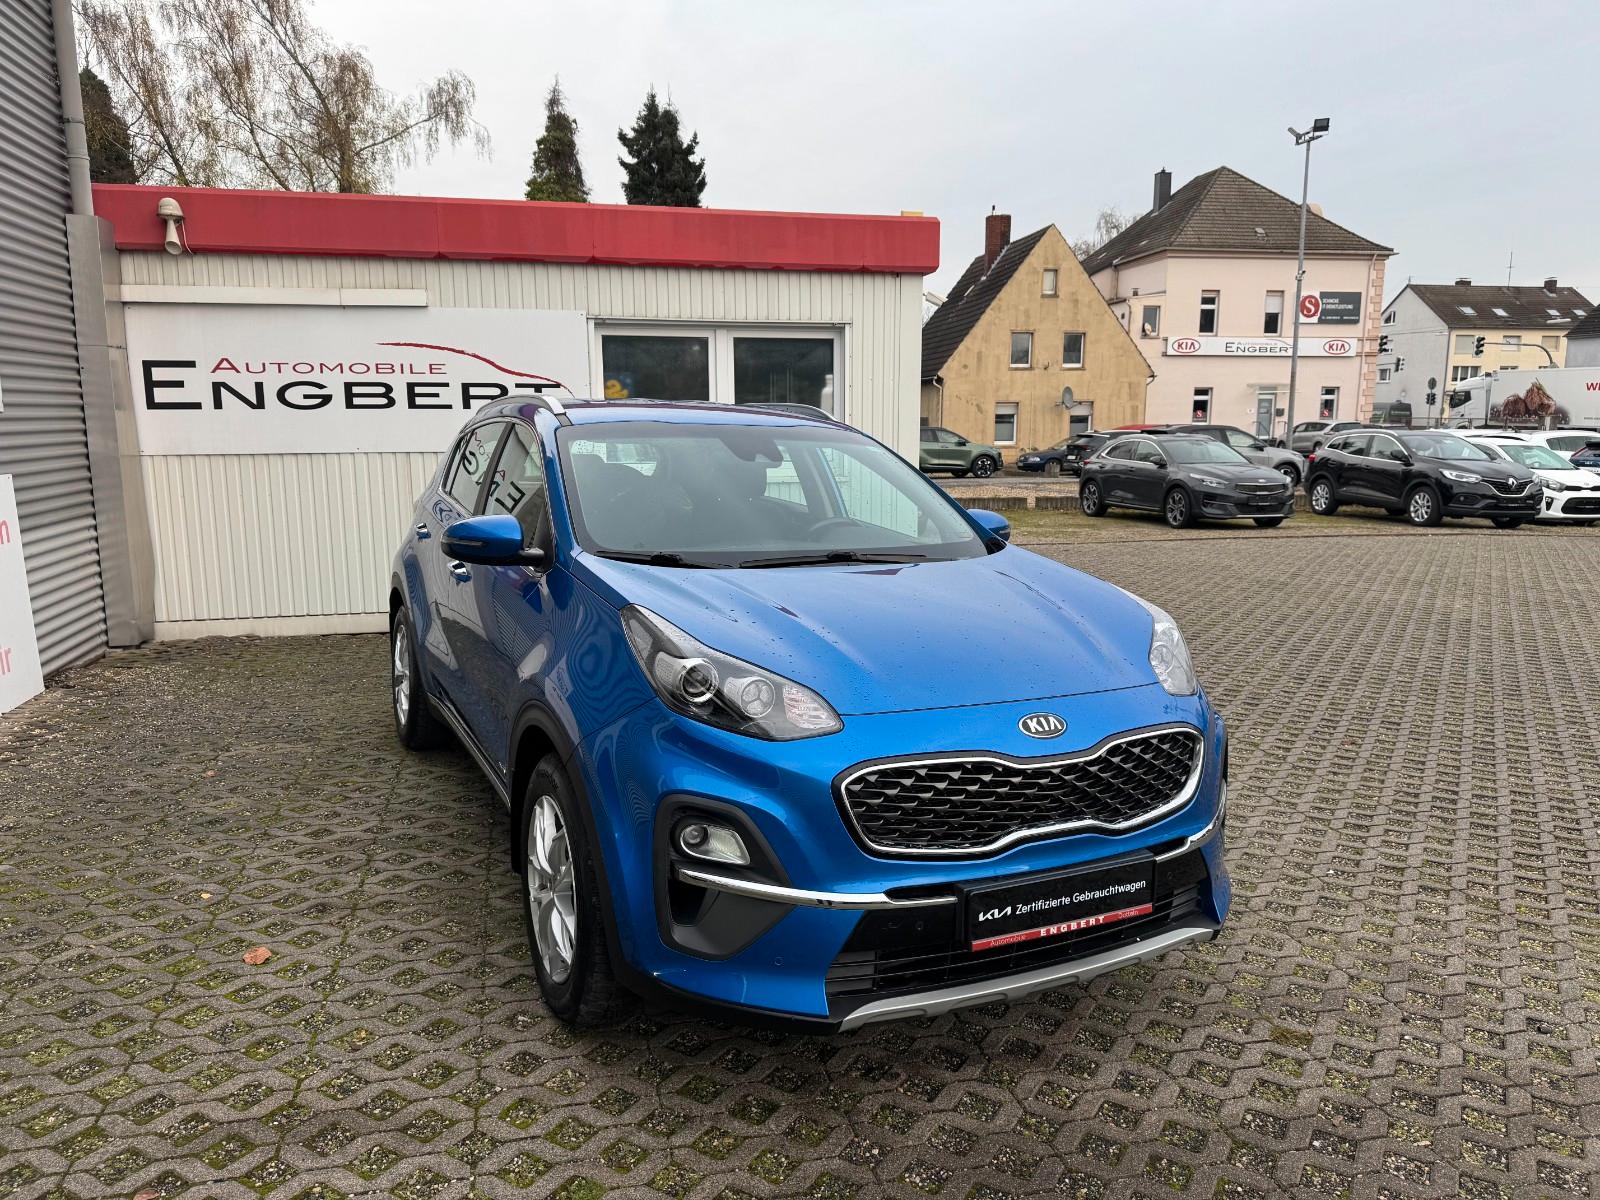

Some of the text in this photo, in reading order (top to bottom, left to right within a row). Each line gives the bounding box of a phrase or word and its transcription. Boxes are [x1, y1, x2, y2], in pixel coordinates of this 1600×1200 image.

[1177, 341, 1196, 351] KIA
[1328, 342, 1346, 352] KIA
[210, 357, 447, 375] AUTOMOBILE
[1026, 716, 1063, 733] KIA
[978, 880, 1147, 922] KIA Zertifizierte Gebrauchtwagen
[1040, 915, 1105, 937] ENGBERT
